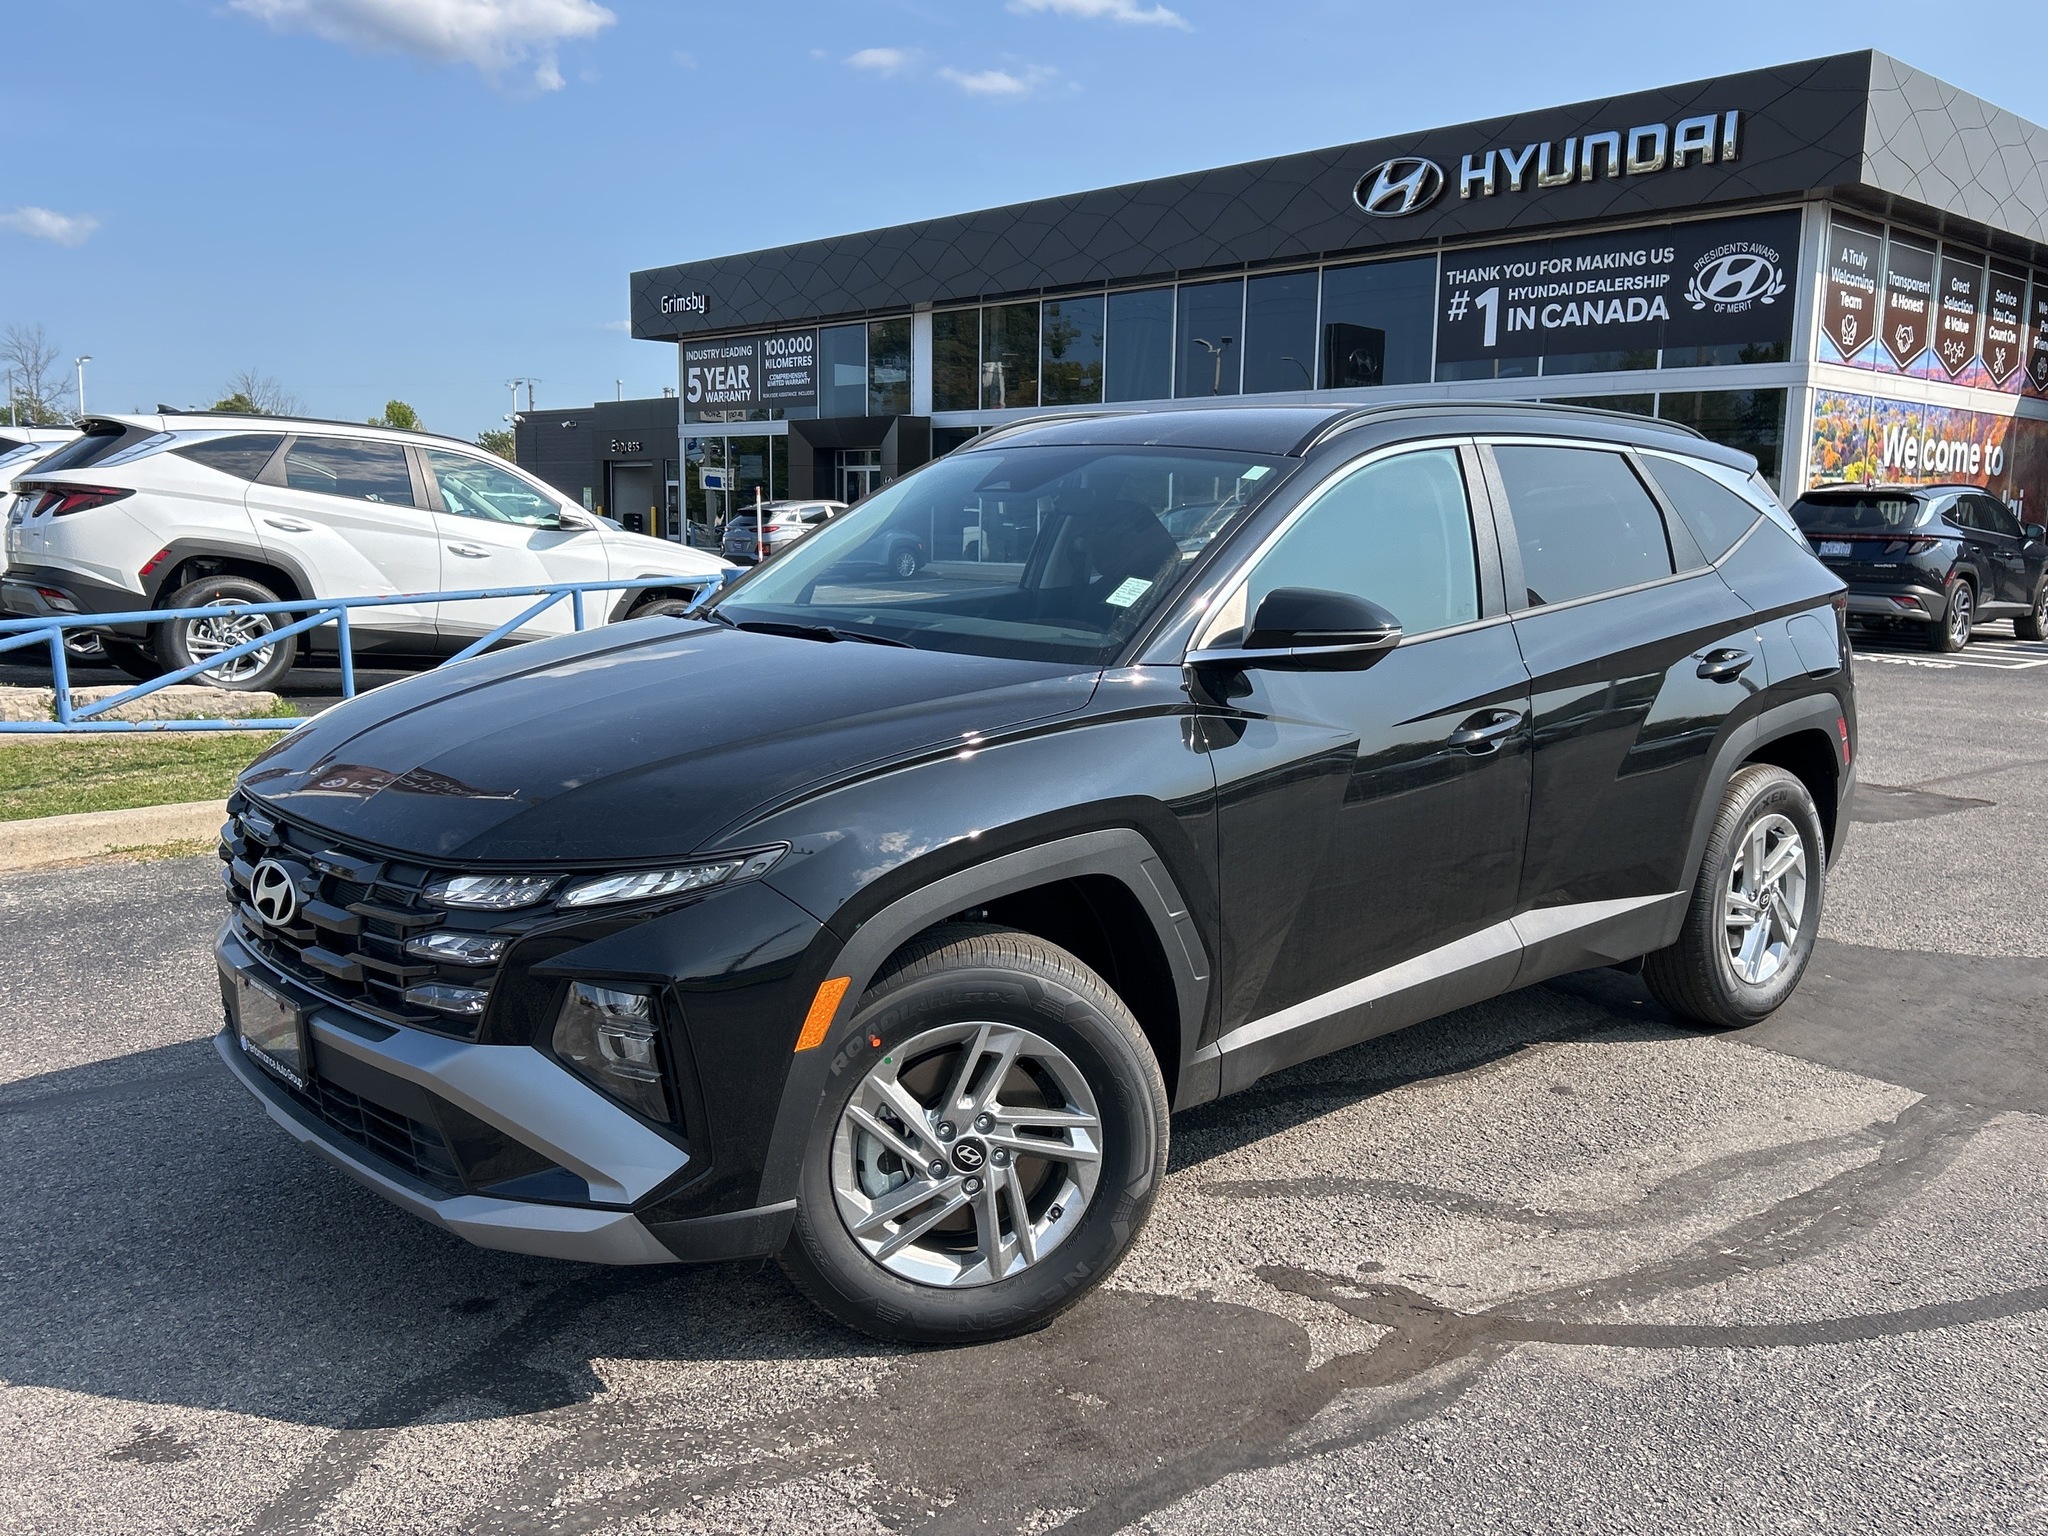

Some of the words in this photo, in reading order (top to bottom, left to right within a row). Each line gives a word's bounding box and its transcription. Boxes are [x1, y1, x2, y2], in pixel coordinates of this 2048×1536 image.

[1459, 110, 1740, 199] HYUNDAI
[1447, 266, 1500, 285] THANK
[1502, 261, 1536, 279] YOU
[1540, 257, 1572, 275] FOR
[1576, 249, 1647, 272] MAKING
[1650, 247, 1675, 263] US
[1693, 242, 1748, 272] PRESIDENT'S
[1749, 243, 1779, 263] AWARD
[1841, 247, 1848, 263] A
[1849, 249, 1868, 270] Truly
[1508, 281, 1573, 301] HYUNDAI
[1576, 274, 1670, 295] DEALERSHIP
[1831, 266, 1874, 294] Welcoming
[1889, 270, 1930, 294] Transparent
[1951, 277, 1970, 294] Great
[661, 291, 705, 314] Grimsby
[1713, 303, 1726, 313] OF
[1727, 300, 1752, 313] MERIT
[1840, 291, 1862, 310] Team
[1891, 292, 1898, 308] &
[1898, 294, 1924, 313] Honest
[1943, 295, 1974, 315] Selection
[1995, 289, 2017, 306] Service
[1507, 305, 1536, 332] IN
[1541, 295, 1670, 329] CANADA
[1944, 315, 1950, 330] &
[1951, 316, 1969, 334] Value
[1992, 307, 2004, 322] You
[2004, 310, 2017, 325] Can
[1989, 325, 2008, 342] Count
[2007, 329, 2017, 344] On
[686, 348, 720, 361] INDUSTRY
[721, 345, 752, 358] LEADING
[764, 335, 813, 357] 100,000
[765, 355, 812, 369] KILOMETRES
[687, 367, 702, 403] 5
[703, 364, 750, 390] YEAR
[705, 389, 752, 403] WARRANTY
[611, 439, 640, 455] Express
[1882, 424, 1981, 475] Welcome
[1984, 438, 2004, 476] to
[1744, 790, 1788, 831] NEXEN
[287, 1068, 303, 1090] Group
